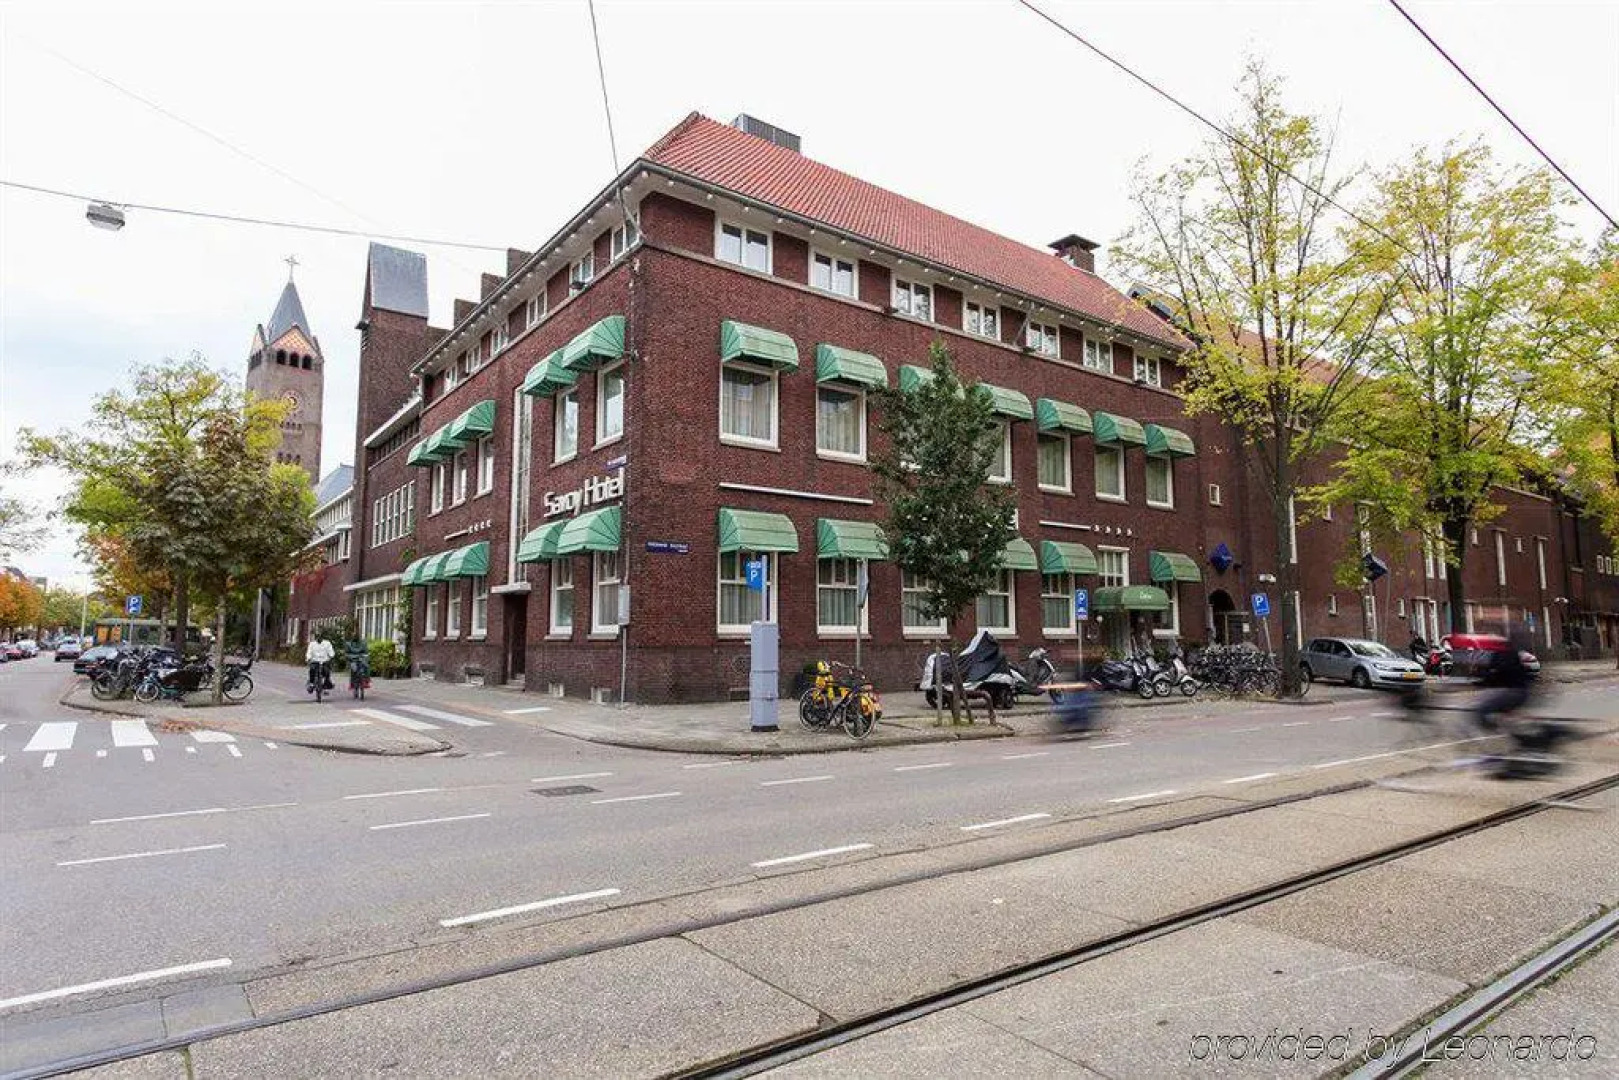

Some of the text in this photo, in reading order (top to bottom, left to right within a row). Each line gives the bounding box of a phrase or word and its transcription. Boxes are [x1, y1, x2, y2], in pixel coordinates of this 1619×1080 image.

[584, 467, 625, 505] Hotel
[750, 570, 758, 582] P
[1255, 595, 1264, 606] P
